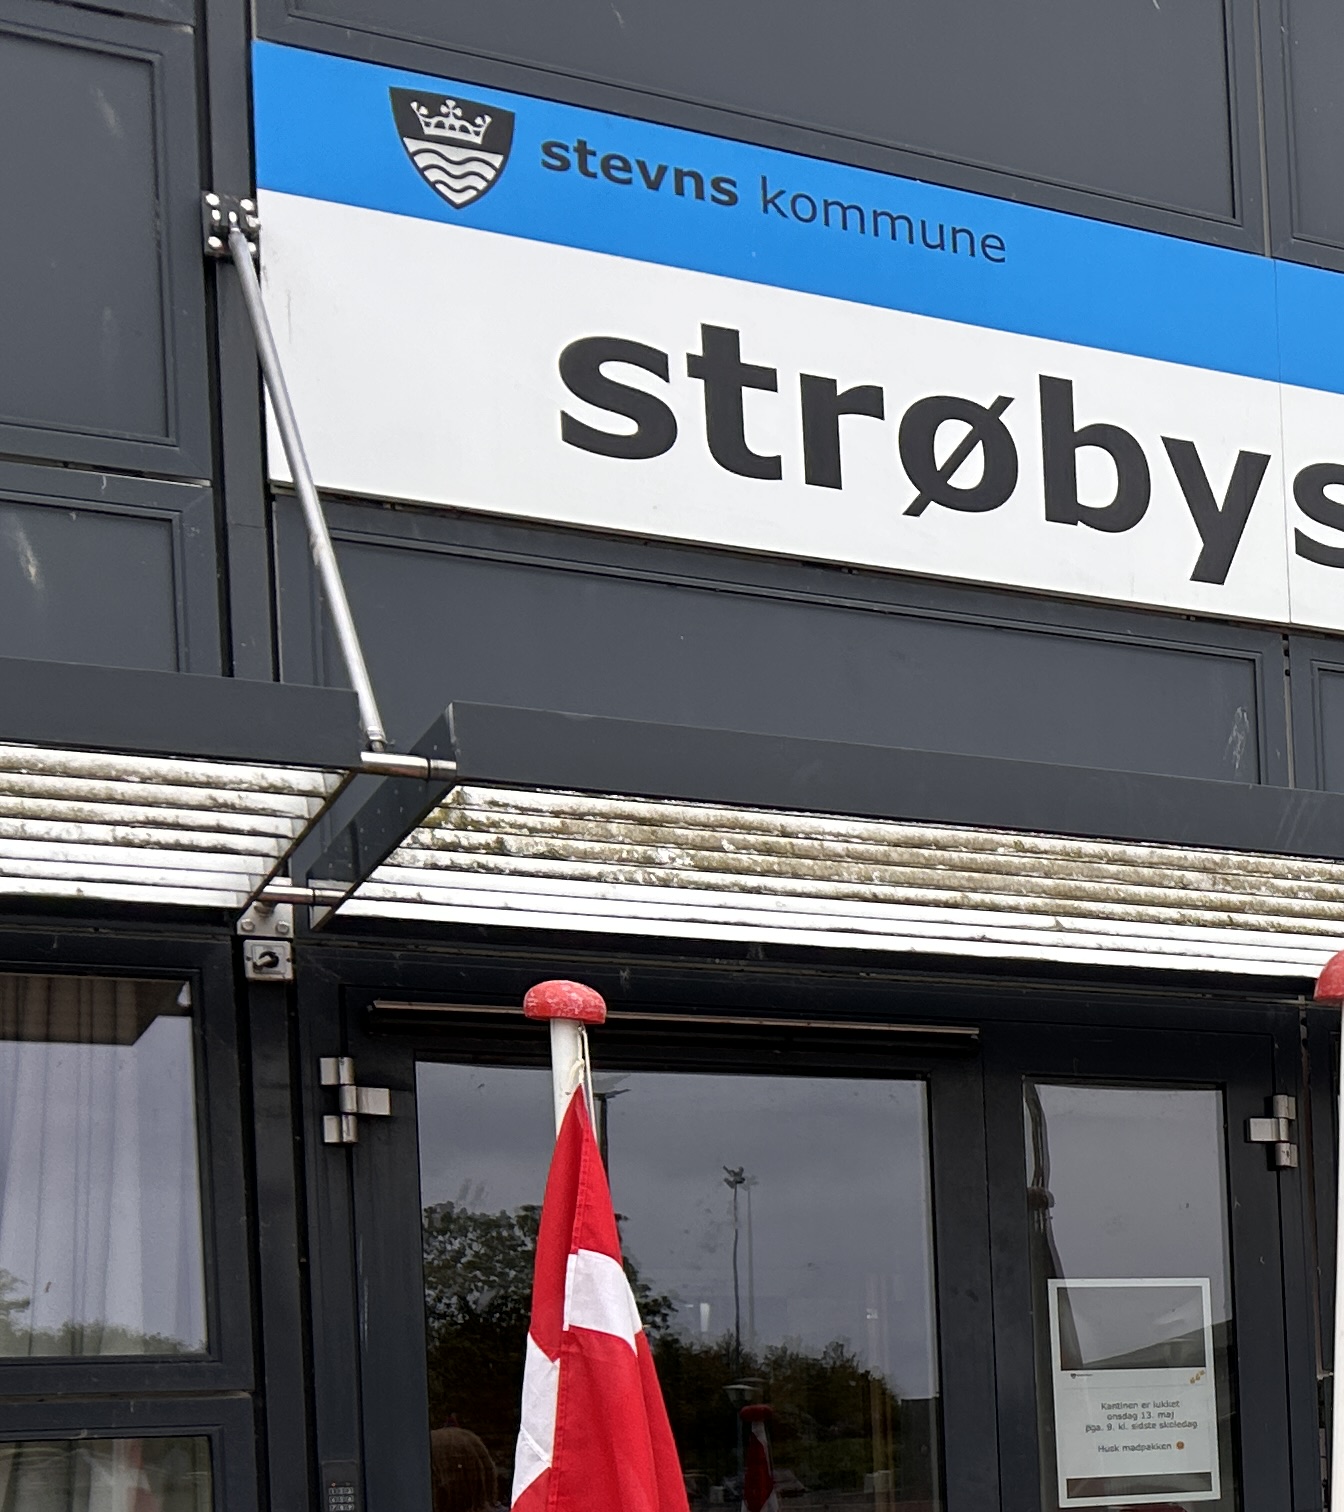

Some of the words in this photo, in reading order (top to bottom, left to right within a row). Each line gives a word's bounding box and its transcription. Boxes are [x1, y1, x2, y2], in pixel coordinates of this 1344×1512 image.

[541, 135, 739, 207] stevns
[760, 175, 1008, 264] kommune
[1101, 1401, 1138, 1410] Kantinen
[1153, 1400, 1180, 1408] lukket
[1107, 1412, 1138, 1421] onsdag
[1157, 1411, 1175, 1420] maj
[1085, 1424, 1104, 1433] pga.
[1131, 1421, 1156, 1430] sidste
[1159, 1420, 1198, 1429] skoledag
[1122, 1443, 1172, 1452] madpakken
